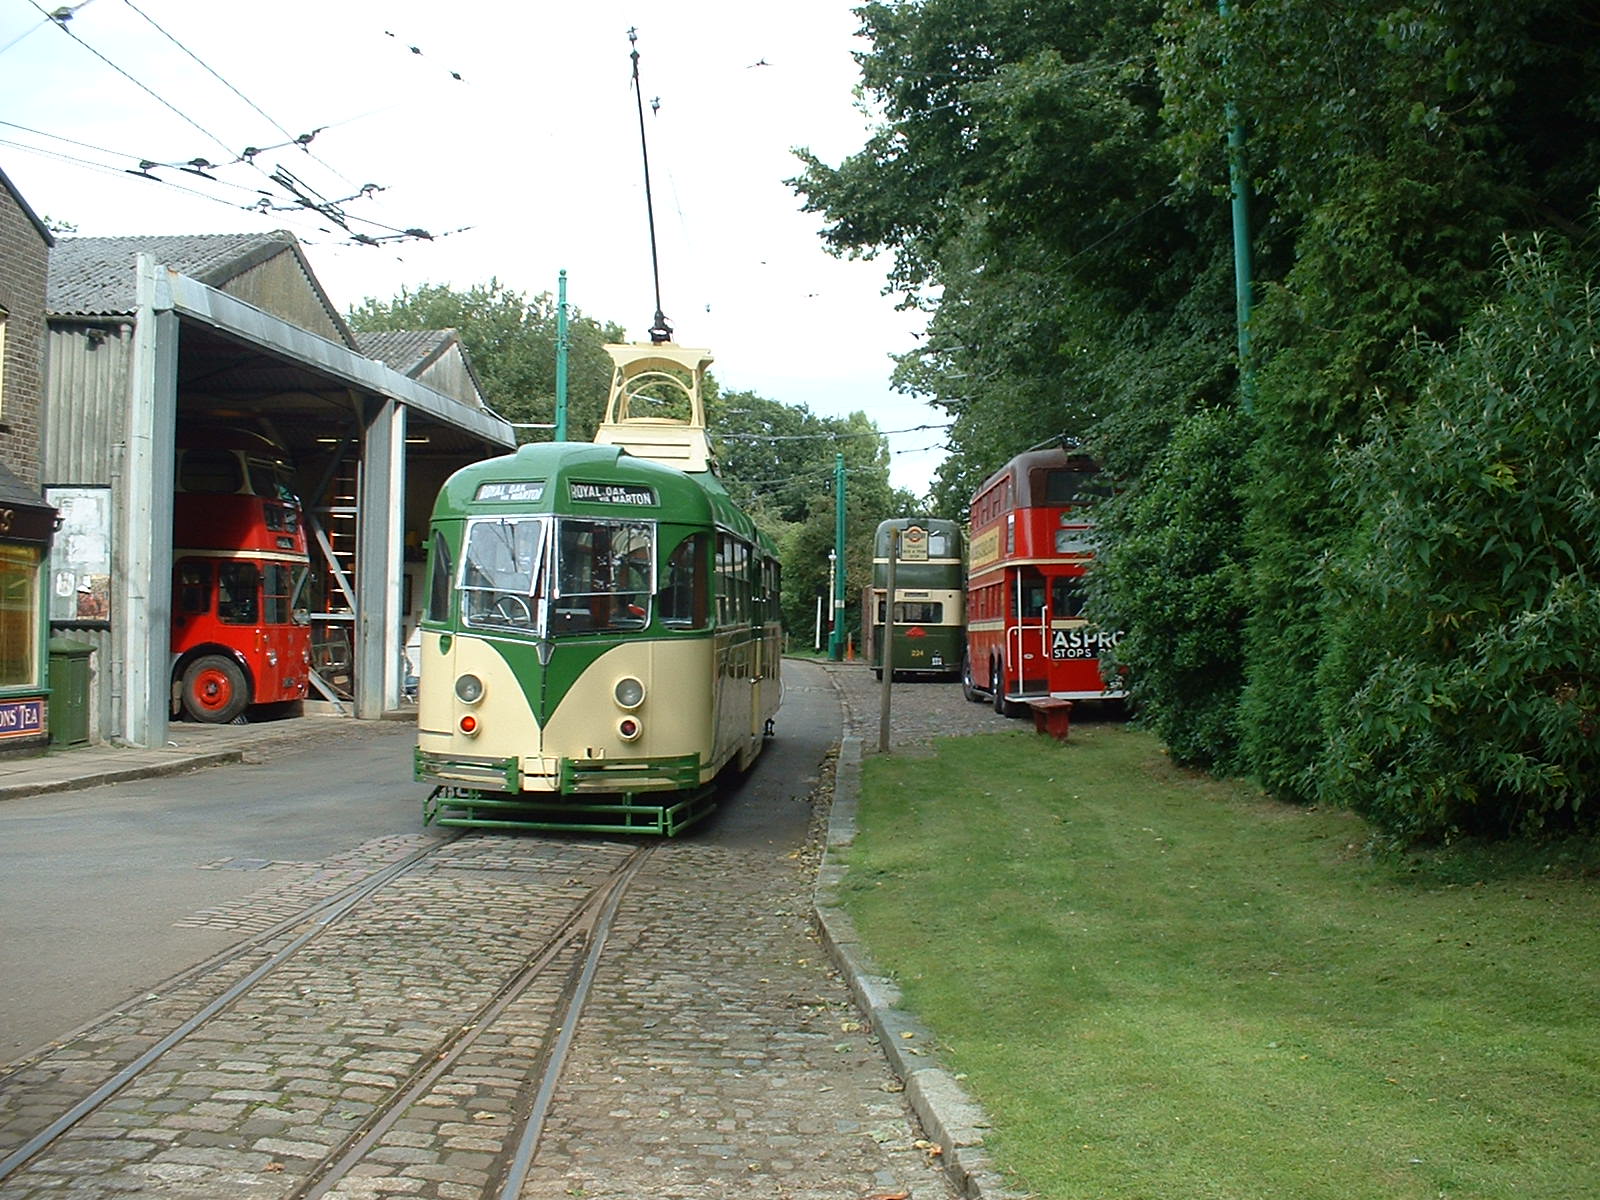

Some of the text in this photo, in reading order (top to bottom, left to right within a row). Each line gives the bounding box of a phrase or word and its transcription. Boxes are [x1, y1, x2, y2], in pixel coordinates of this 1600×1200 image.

[571, 484, 626, 499] ROYAL OAK
[611, 492, 652, 505] MARTON
[1054, 648, 1092, 658] STOPS
[20, 704, 38, 729] TEA
